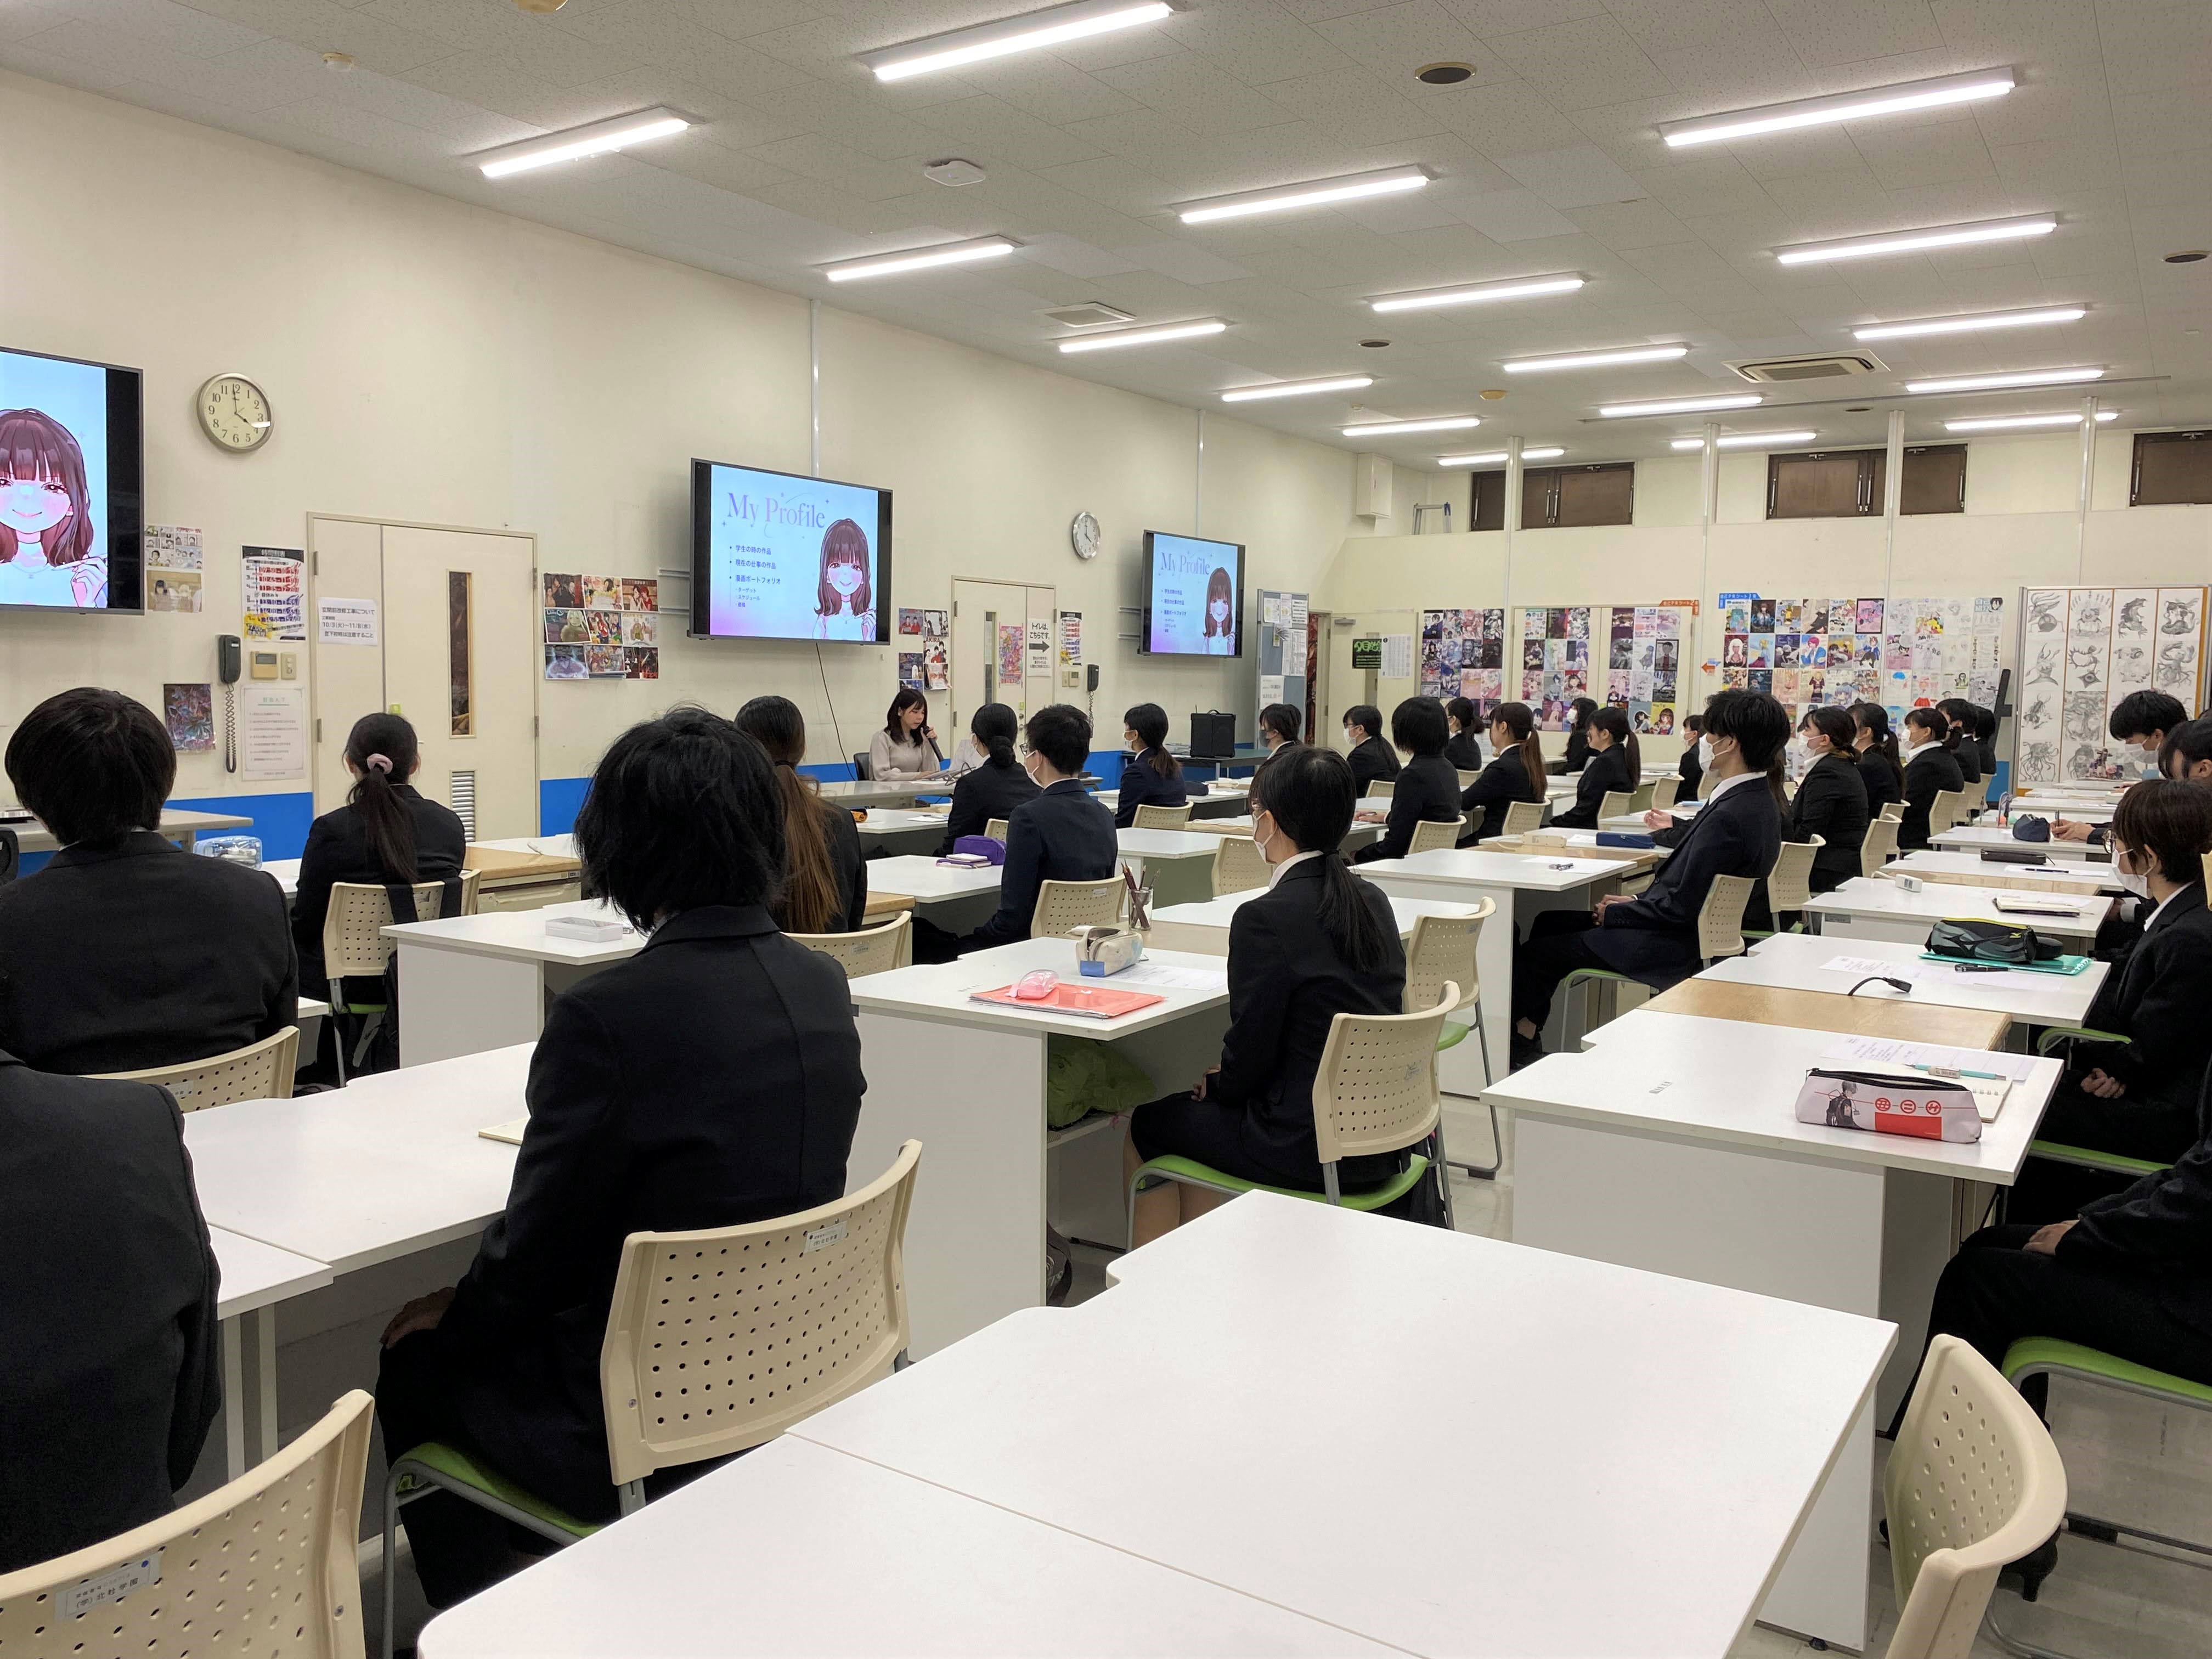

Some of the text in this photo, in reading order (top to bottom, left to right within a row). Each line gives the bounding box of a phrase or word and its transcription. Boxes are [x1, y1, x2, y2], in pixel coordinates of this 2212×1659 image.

[221, 385, 228, 394] 11
[233, 384, 240, 394] 2
[212, 393, 221, 403] 10
[247, 390, 250, 399] 1
[254, 399, 259, 409] 2
[208, 405, 215, 415] 9
[257, 413, 263, 422] 3
[213, 419, 219, 428] 8
[222, 429, 228, 438] 7
[233, 433, 239, 443] 6
[245, 433, 251, 442] 5
[727, 492, 825, 528] My Profile
[736, 545, 771, 555] 学生の時の作品
[736, 559, 776, 569] 現在の仕事の作品
[1180, 555, 1210, 575] Profile
